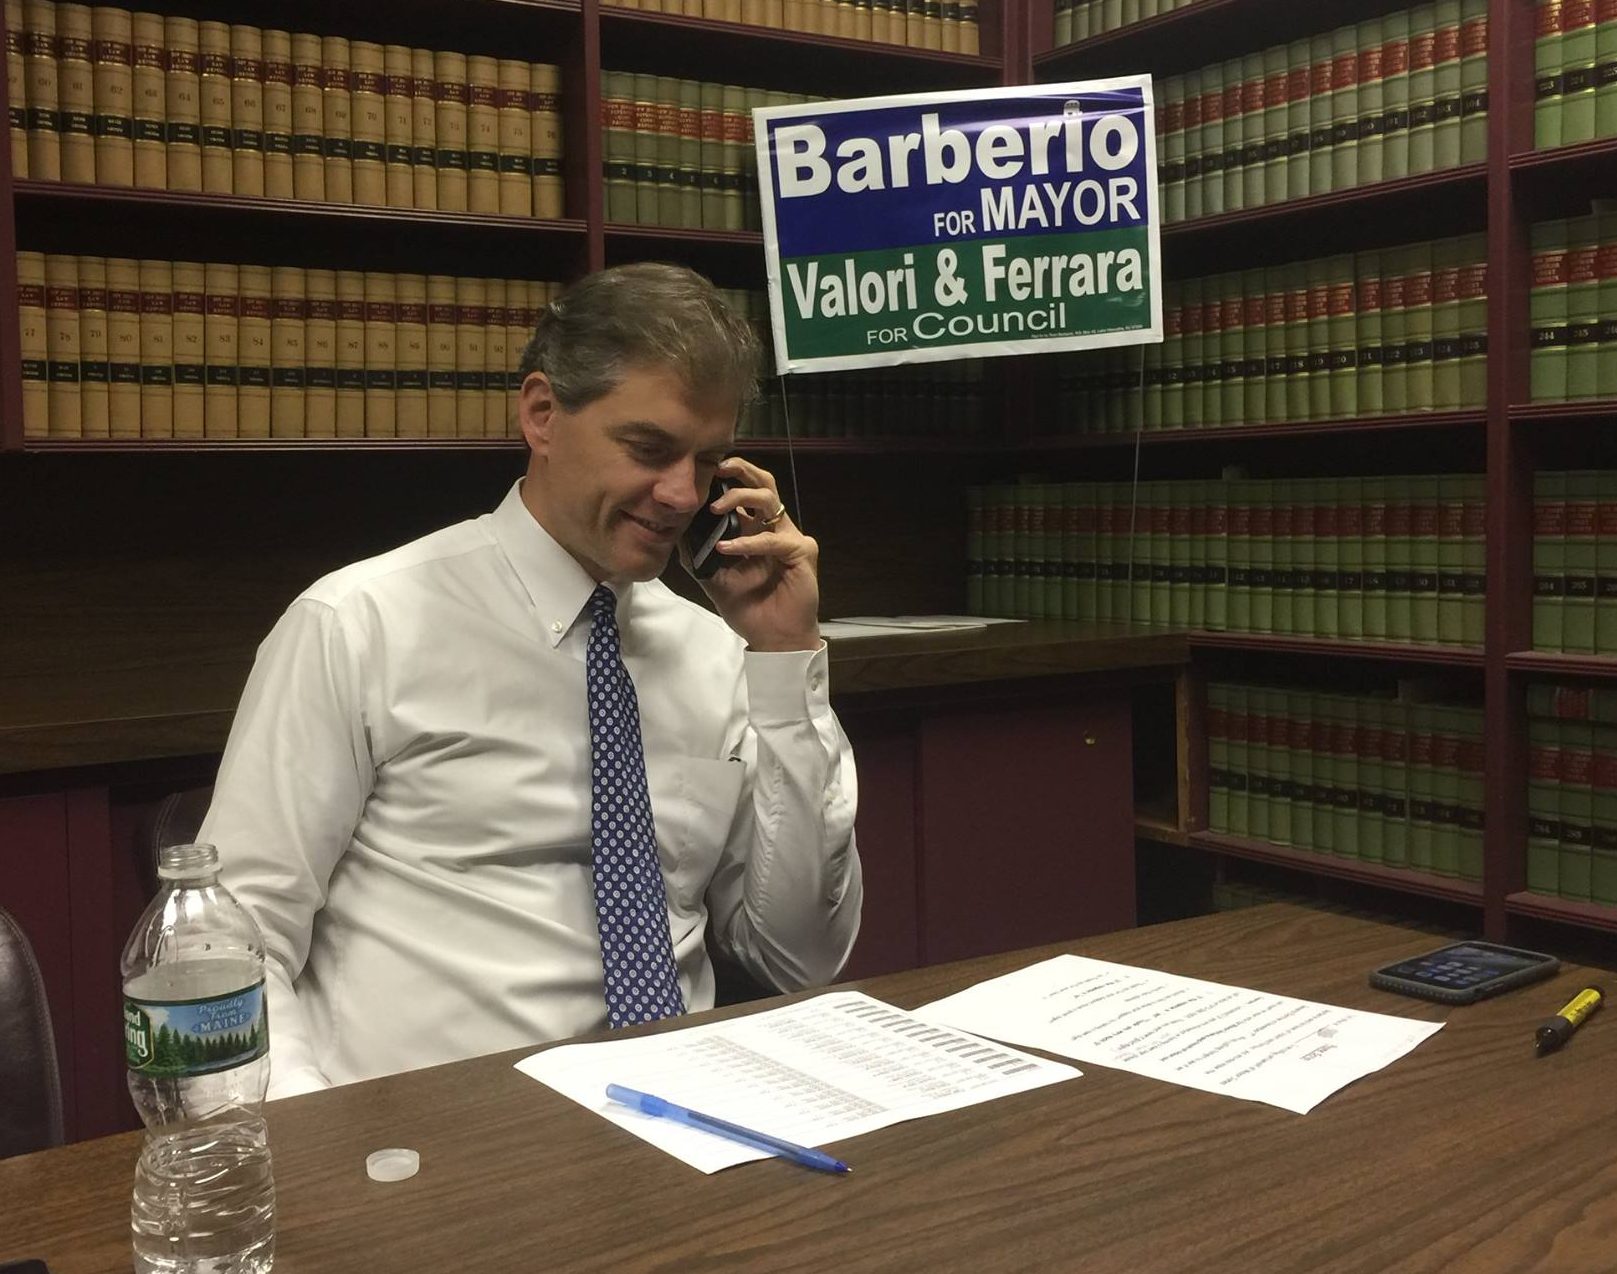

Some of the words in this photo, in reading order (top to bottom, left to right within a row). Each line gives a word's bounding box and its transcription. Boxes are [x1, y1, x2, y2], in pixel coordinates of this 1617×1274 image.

[774, 100, 1139, 198] Barberio
[934, 210, 976, 236] FOR
[980, 176, 1141, 232] MAYOR
[786, 253, 918, 319] Valori
[934, 248, 968, 306] &
[982, 244, 1143, 302] Ferrara
[866, 327, 908, 345] FOR
[912, 302, 1066, 340] Council
[124, 1010, 140, 1027] nd
[199, 997, 244, 1014] Proudly
[201, 1012, 248, 1032] MAINE
[125, 1022, 148, 1058] ing
